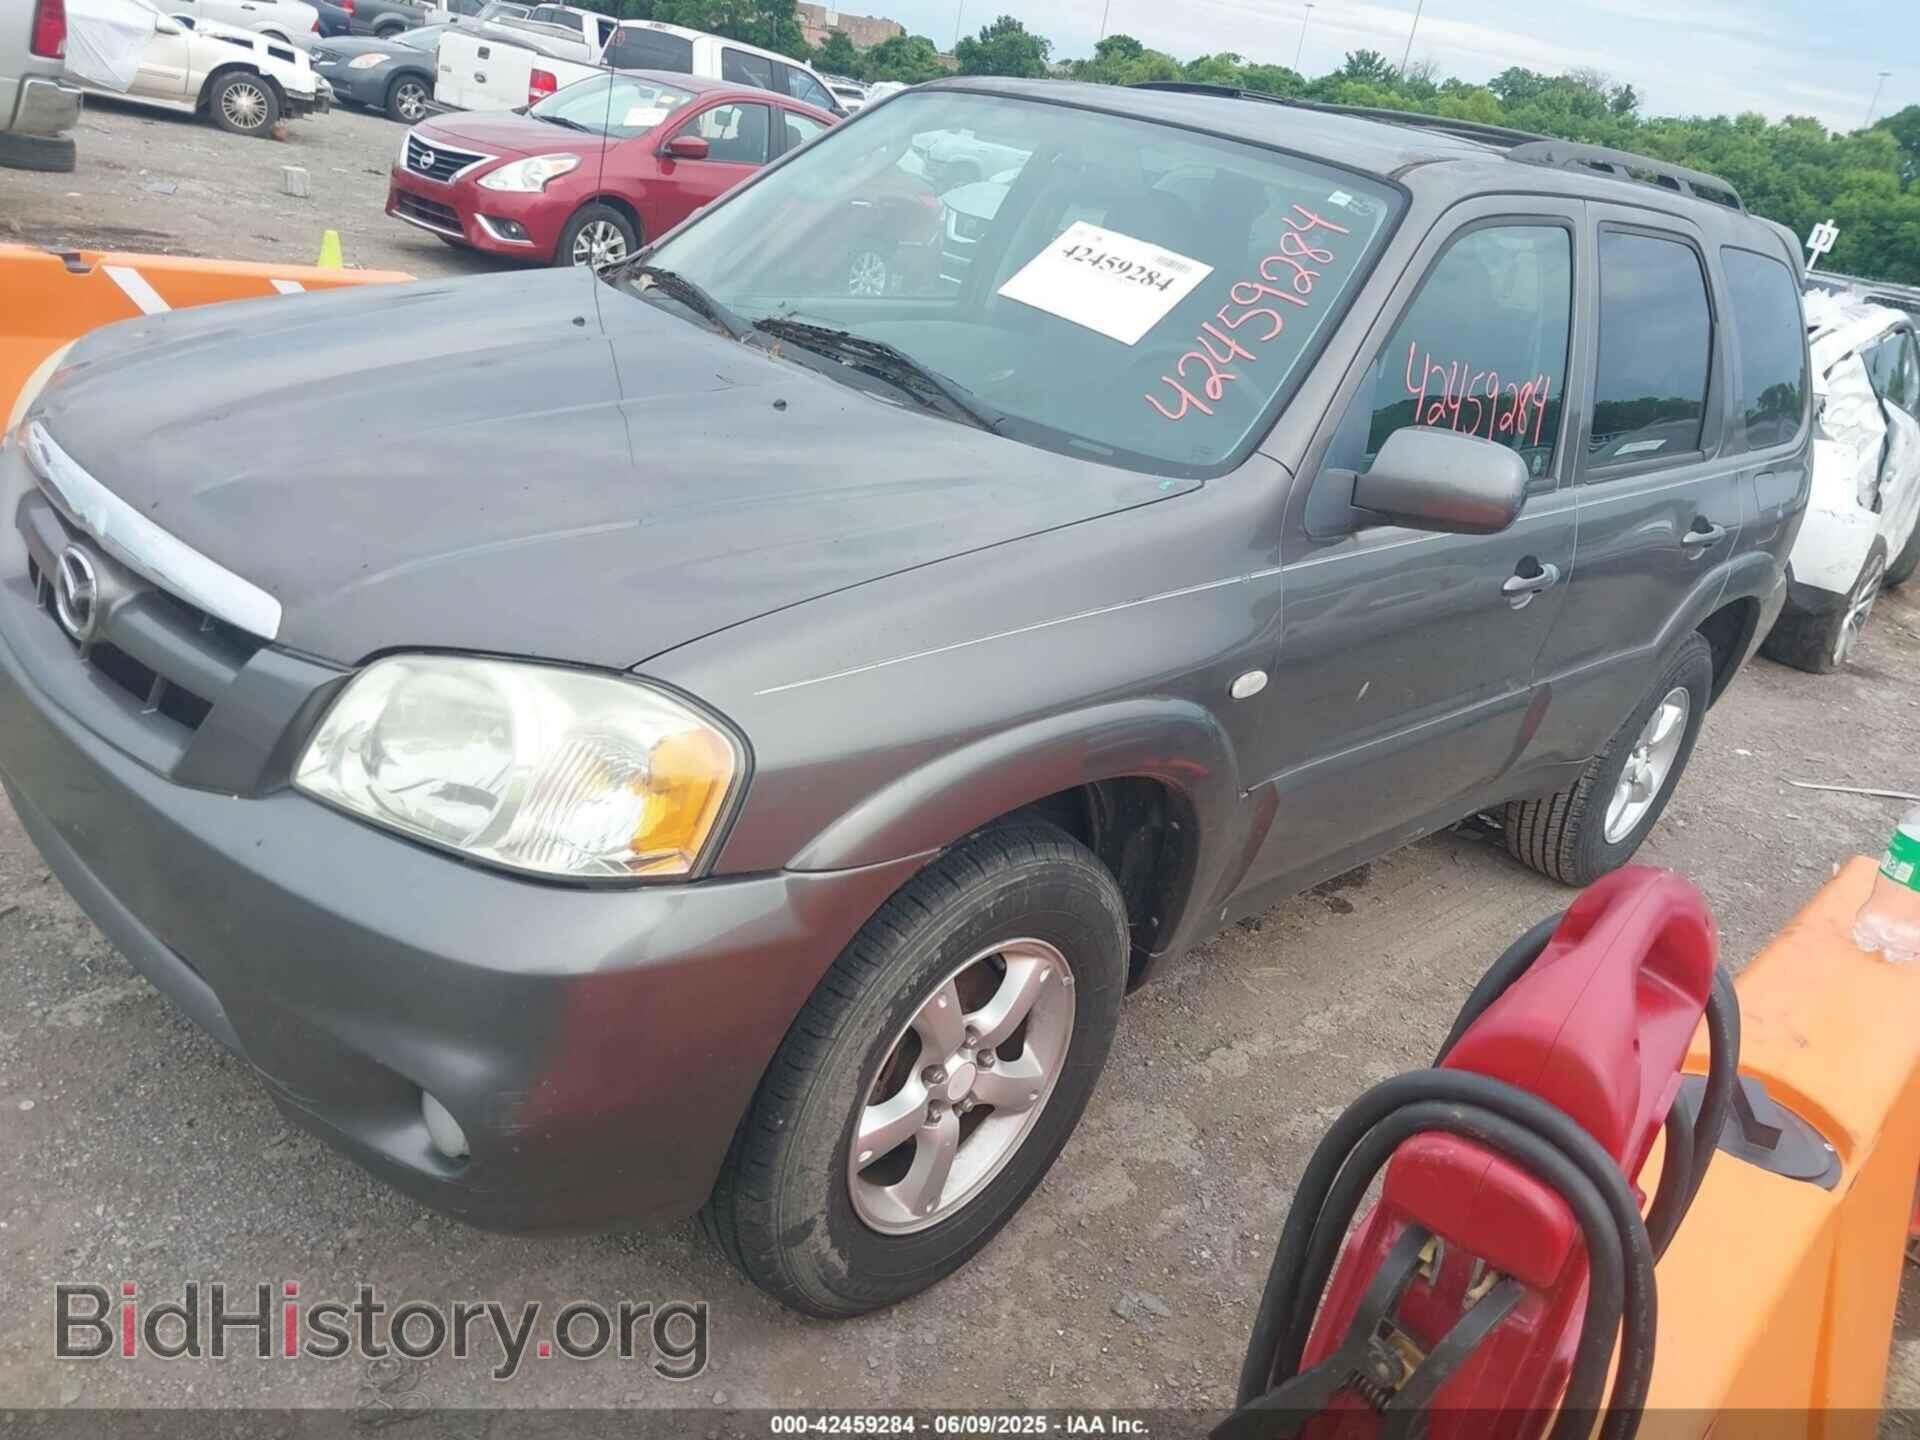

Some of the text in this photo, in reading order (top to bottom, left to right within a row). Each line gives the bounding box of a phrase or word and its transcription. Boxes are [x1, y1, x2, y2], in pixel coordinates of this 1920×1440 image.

[1062, 244, 1175, 291] 42459284
[1145, 204, 1350, 420] 42459284
[1406, 341, 1551, 447] 42459284
